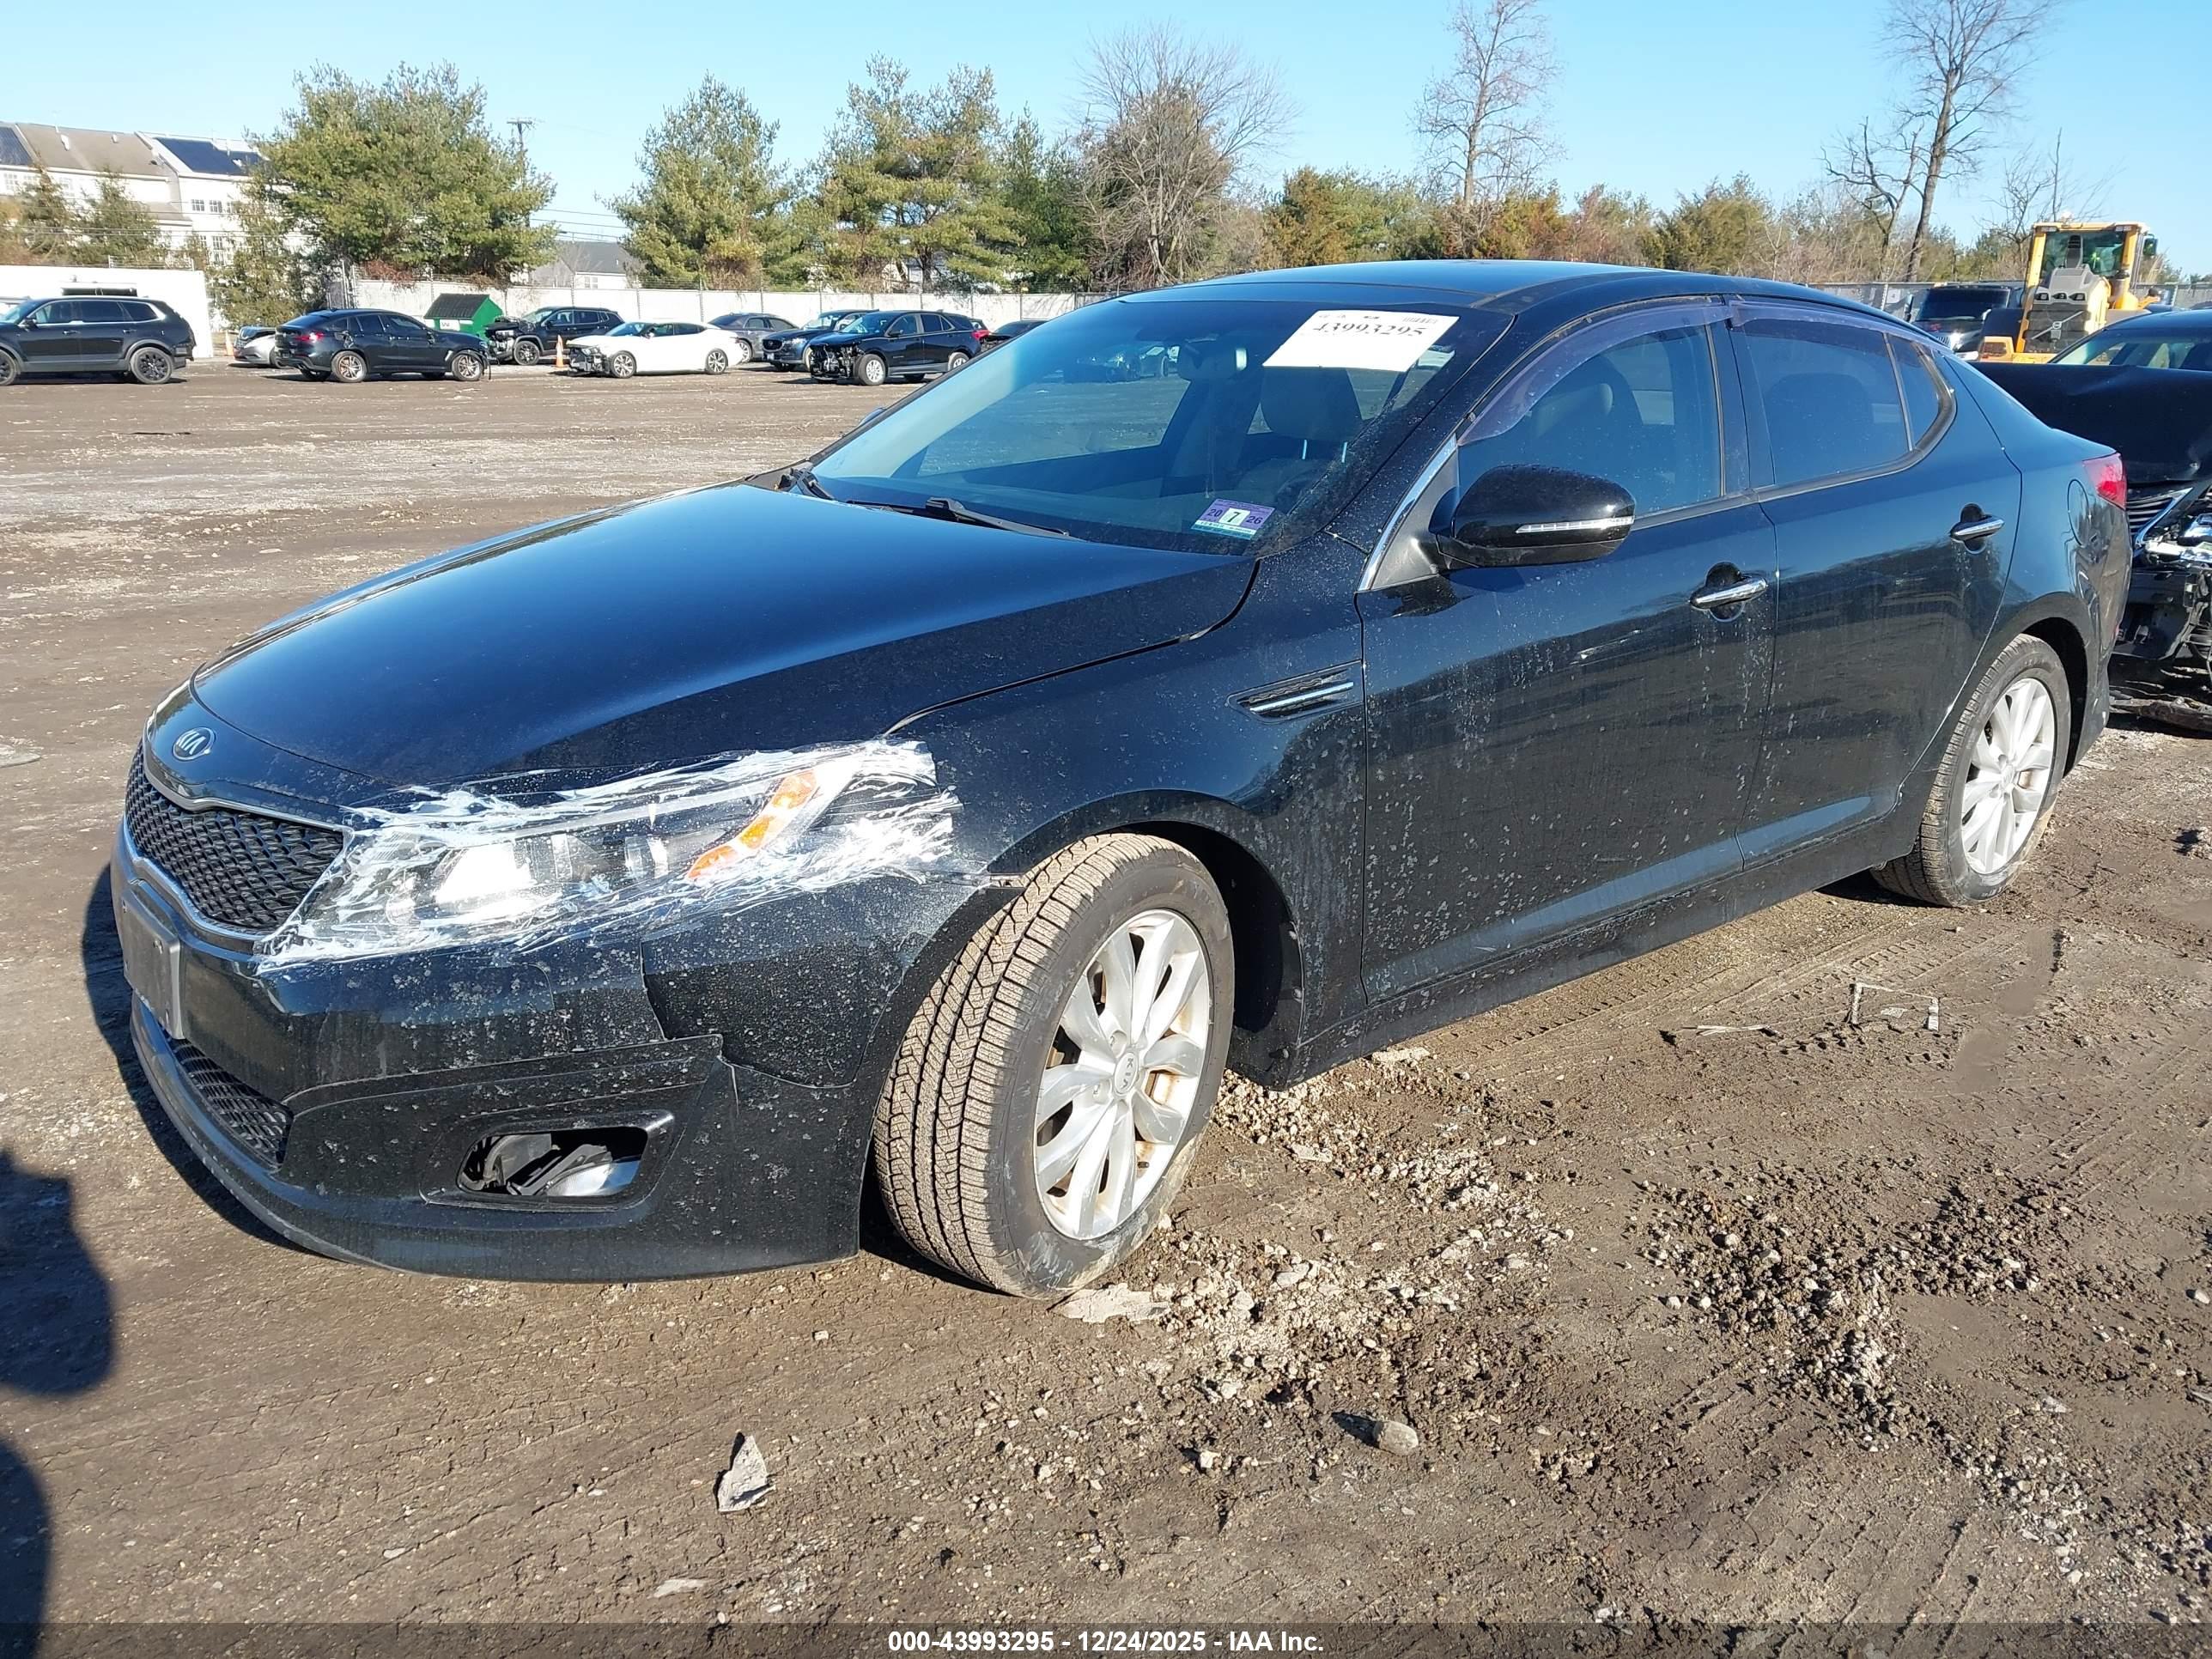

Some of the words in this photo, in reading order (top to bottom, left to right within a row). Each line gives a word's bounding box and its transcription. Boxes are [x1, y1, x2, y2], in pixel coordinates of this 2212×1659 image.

[1207, 508, 1223, 517] 20
[1227, 511, 1243, 523] 7
[1246, 515, 1263, 525] 26
[1120, 1057, 1134, 1090] KIA
